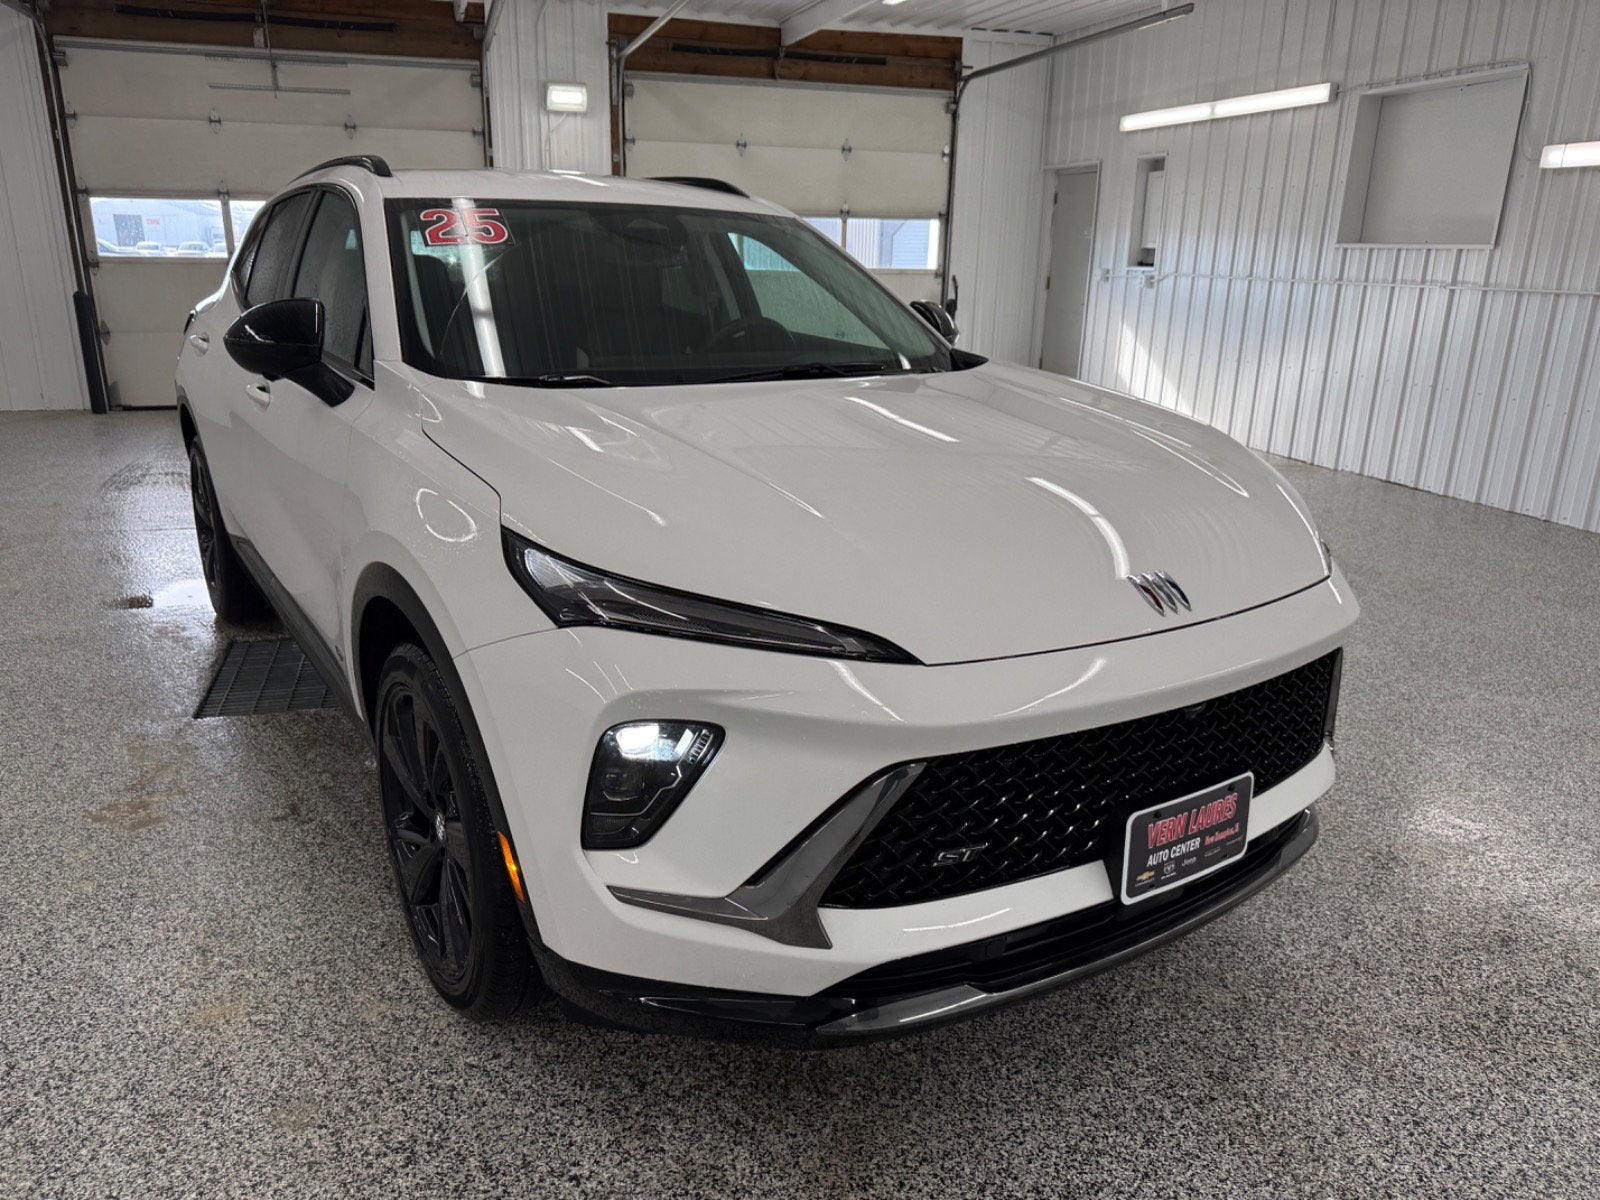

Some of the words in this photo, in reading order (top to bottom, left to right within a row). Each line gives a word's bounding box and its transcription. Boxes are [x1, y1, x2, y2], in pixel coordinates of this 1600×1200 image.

[420, 208, 508, 245] 25
[1148, 812, 1188, 848] VERN
[1189, 793, 1238, 834] LAURES
[1146, 848, 1170, 868] AUTO
[1170, 837, 1201, 859] CENTER
[1181, 856, 1197, 867] Jeep
